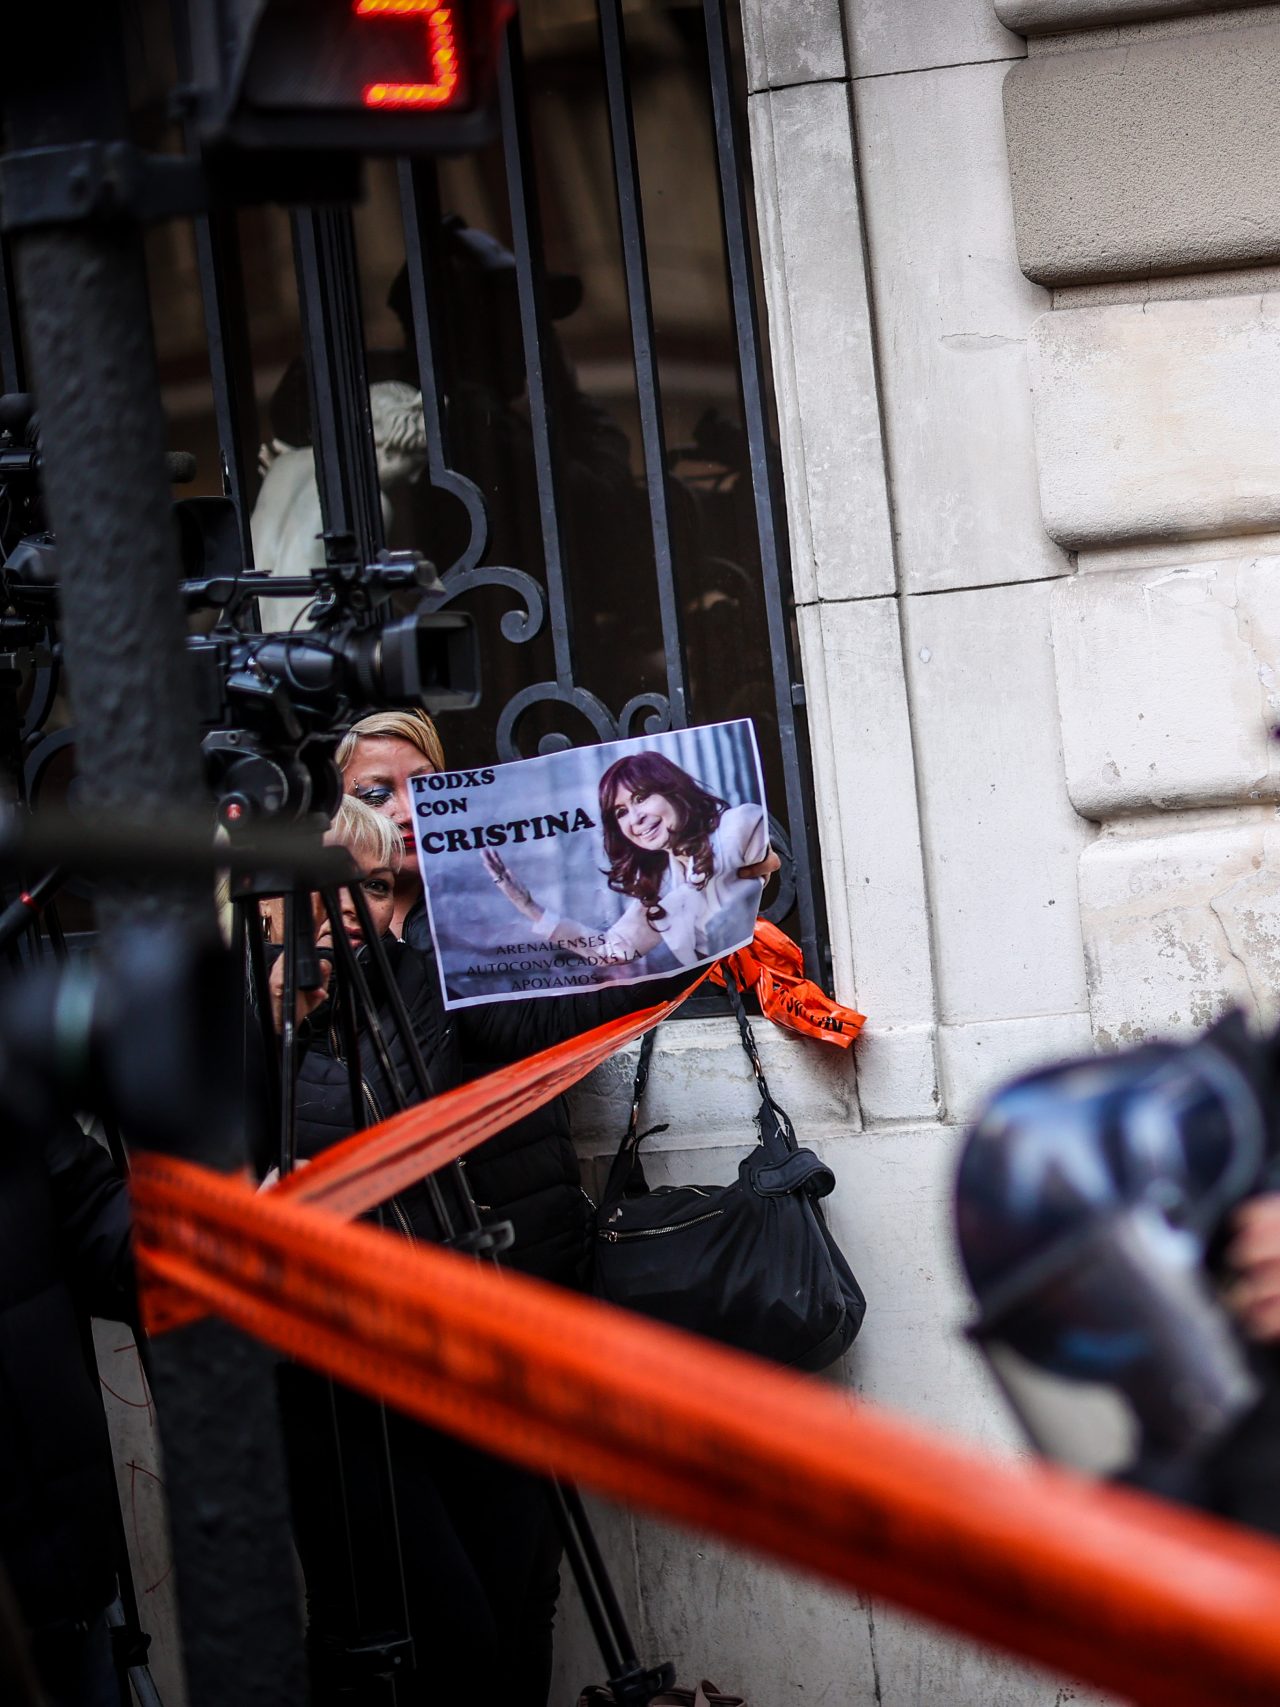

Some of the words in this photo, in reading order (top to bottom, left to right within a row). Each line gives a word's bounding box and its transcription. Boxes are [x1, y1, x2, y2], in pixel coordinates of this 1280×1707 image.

[411, 768, 495, 793] TODXS
[416, 798, 468, 818] CON
[421, 808, 596, 855] CRISTINA
[496, 933, 606, 955] ARENALENSES
[467, 953, 618, 976] AUTOCONVOCADXS
[624, 949, 642, 961] LA
[511, 974, 599, 991] APOYAMOS
